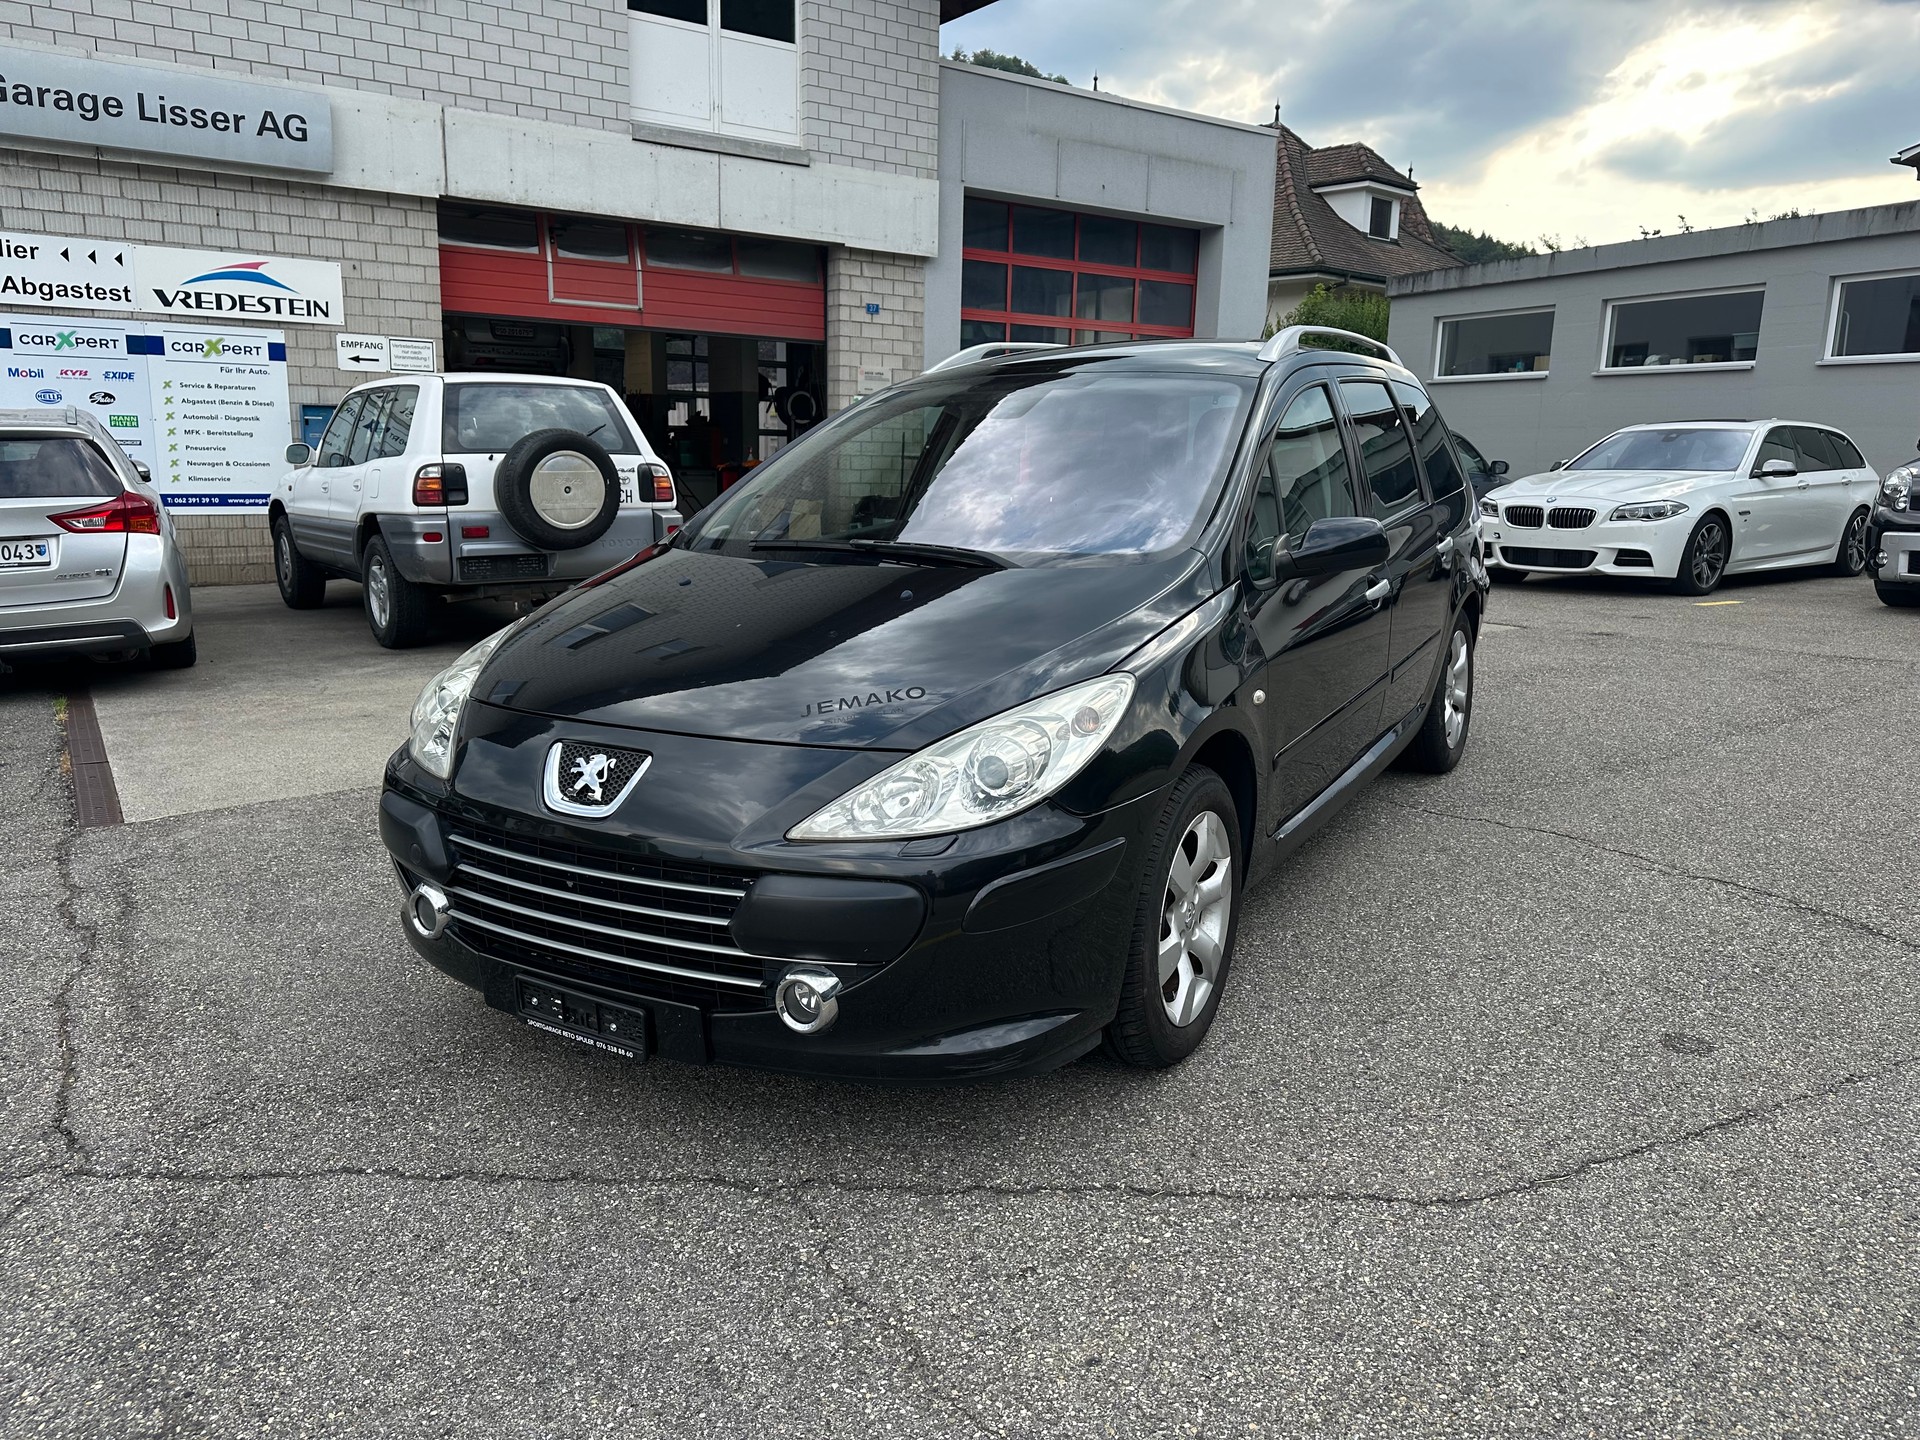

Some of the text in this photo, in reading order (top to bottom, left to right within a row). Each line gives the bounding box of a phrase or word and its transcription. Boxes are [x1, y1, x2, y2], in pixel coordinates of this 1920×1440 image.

[136, 91, 246, 134] Lisser
[256, 109, 309, 142] AG
[1, 275, 132, 303] Abgastest
[151, 288, 330, 318] VREDESTEIN
[868, 304, 877, 312] 37
[340, 340, 384, 350] EMPFANG
[8, 367, 44, 379] Mobil
[60, 369, 89, 377] KYB
[103, 370, 135, 380] EXIDE
[219, 366, 233, 374] Für
[179, 382, 205, 390] Service
[214, 383, 256, 392] Reparaturen
[181, 398, 216, 406] Abgastest
[218, 399, 243, 407] (Benzin
[252, 400, 275, 408] Diesel)
[182, 413, 219, 421] Automobil
[224, 414, 260, 423] Diagnostik
[206, 430, 254, 438] Bereitstellung
[186, 460, 224, 468] Neuwagen
[232, 460, 271, 468] Occasionen
[188, 475, 231, 483] Klimaservice
[801, 686, 926, 717] JEMAKO
[527, 1019, 562, 1035] SPORTGARAGE
[562, 1030, 576, 1040] RETO
[596, 1041, 607, 1050] 076
